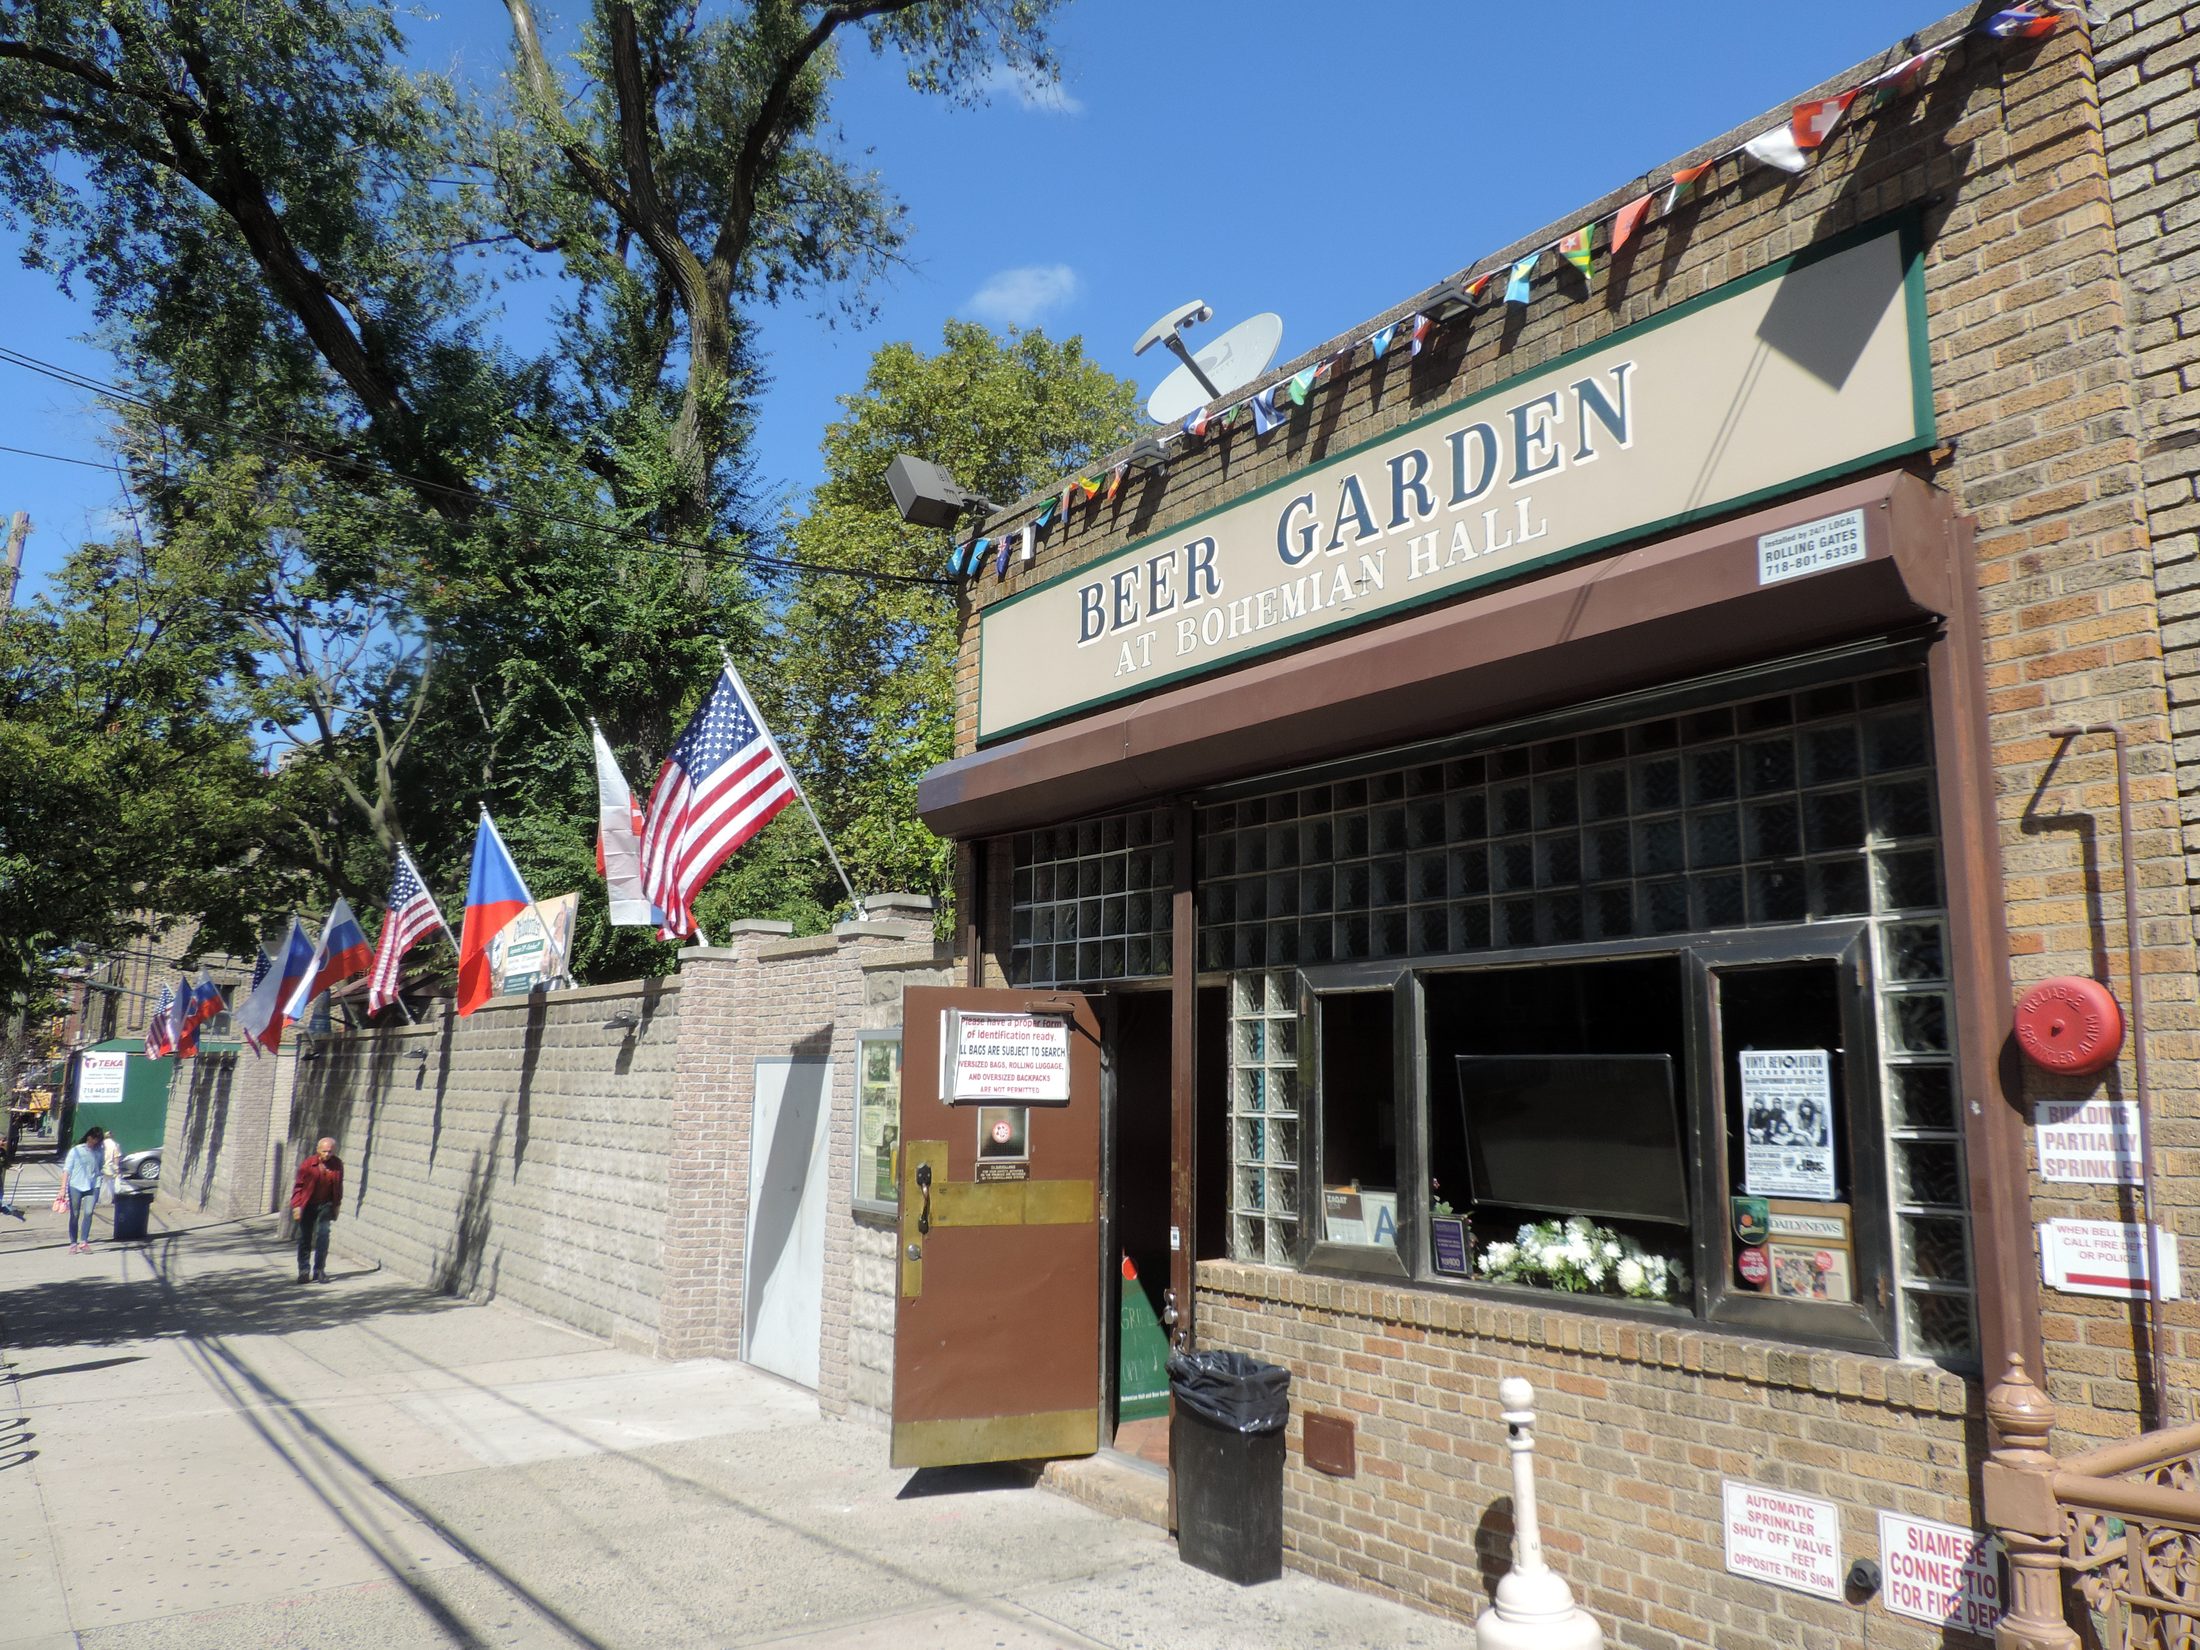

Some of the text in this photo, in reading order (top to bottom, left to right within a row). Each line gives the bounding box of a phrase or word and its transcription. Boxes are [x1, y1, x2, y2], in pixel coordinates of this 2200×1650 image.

[1076, 360, 1637, 649] BEER GARDEN
[1764, 516, 1857, 549] Installed by 24/7 LOCAL
[1765, 528, 1858, 563] ROLLING GATES
[1766, 543, 1858, 576] 718-801-6339
[1114, 496, 1549, 677] AT BOHEMIAN HALL
[2023, 986, 2086, 1014] RELIABLE
[961, 1016, 985, 1026] Please
[987, 1017, 1006, 1026] have
[1014, 1019, 1041, 1028] proper
[1042, 1019, 1062, 1028] form
[967, 1030, 976, 1039] of
[1033, 1032, 1057, 1042] ready.
[2079, 1013, 2100, 1056] ALARM
[969, 1044, 986, 1056] BAGS
[988, 1045, 1000, 1056] ARE
[1002, 1045, 1029, 1057] SUBJECT
[1031, 1046, 1040, 1057] TO
[1041, 1046, 1066, 1058] SEARCH
[99, 1059, 124, 1067] TEKA
[959, 1060, 1065, 1071] VERSIZED BAGS, ROLLING LUGGAGE,
[982, 1074, 1015, 1082] OVERSIZED
[1017, 1074, 1051, 1082] BACKPACKS
[994, 1086, 1005, 1094] NOT
[2048, 1105, 2130, 1126] BUILDING
[2045, 1132, 2138, 1153] PARTIALLY
[1326, 1194, 1347, 1204] ZAGAT
[1374, 1205, 1398, 1244] A
[1770, 1217, 1841, 1233] DAILY NEWS
[2057, 1225, 2089, 1236] WHEN
[2092, 1228, 2119, 1238] BELL
[2064, 1238, 2147, 1251] CALL FIRE DEP
[2079, 1251, 2138, 1264] OR POLICE
[1746, 1494, 1815, 1520] AUTOMATIC
[1747, 1510, 1815, 1536] SPRINKLER
[1732, 1522, 1833, 1558] SHUT OFF VALVE
[1907, 1527, 1988, 1568] SIAMESE
[1734, 1553, 1835, 1589] OPPOSITE THIS SIGN
[1791, 1552, 1817, 1569] FEET
[1890, 1552, 1999, 1600] CONNECTIO
[1892, 1581, 2000, 1630] FOR FIRE DEP
